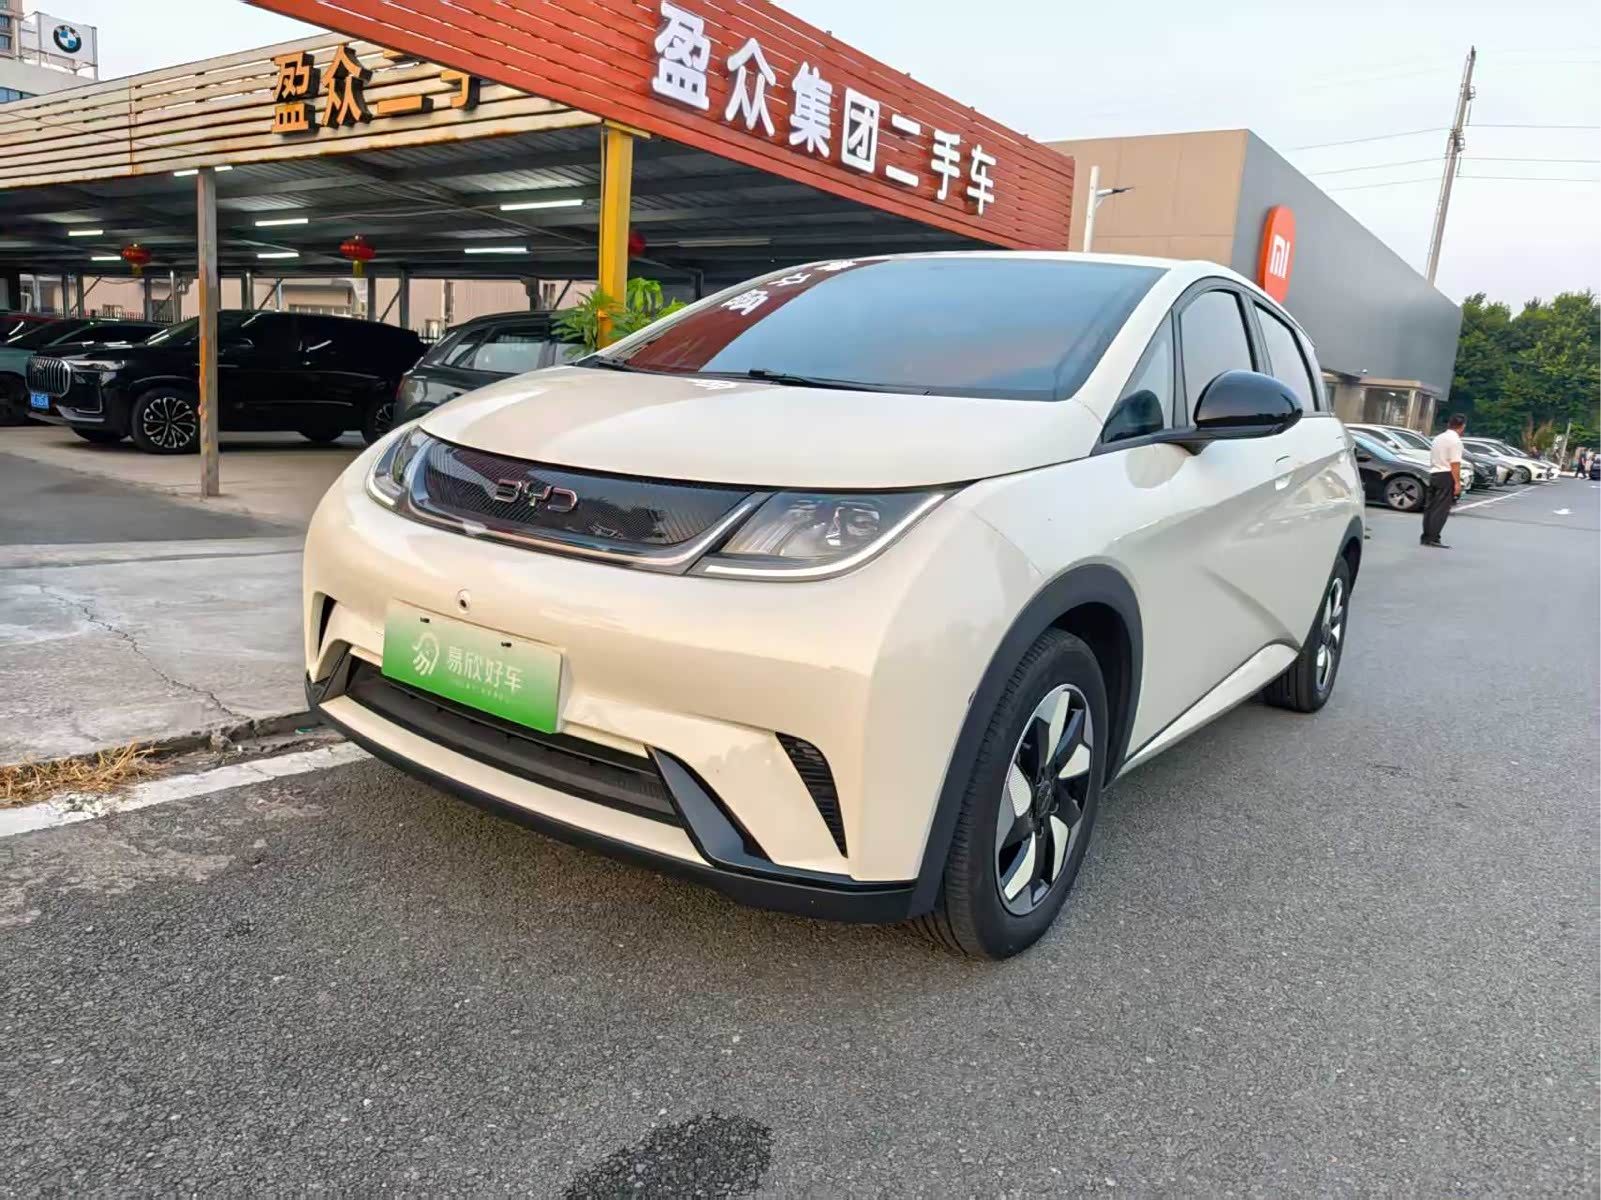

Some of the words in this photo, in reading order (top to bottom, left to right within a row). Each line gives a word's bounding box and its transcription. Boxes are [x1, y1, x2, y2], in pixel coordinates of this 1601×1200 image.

[652, 0, 997, 217] 盈众集团二手车
[494, 478, 579, 513] BYD
